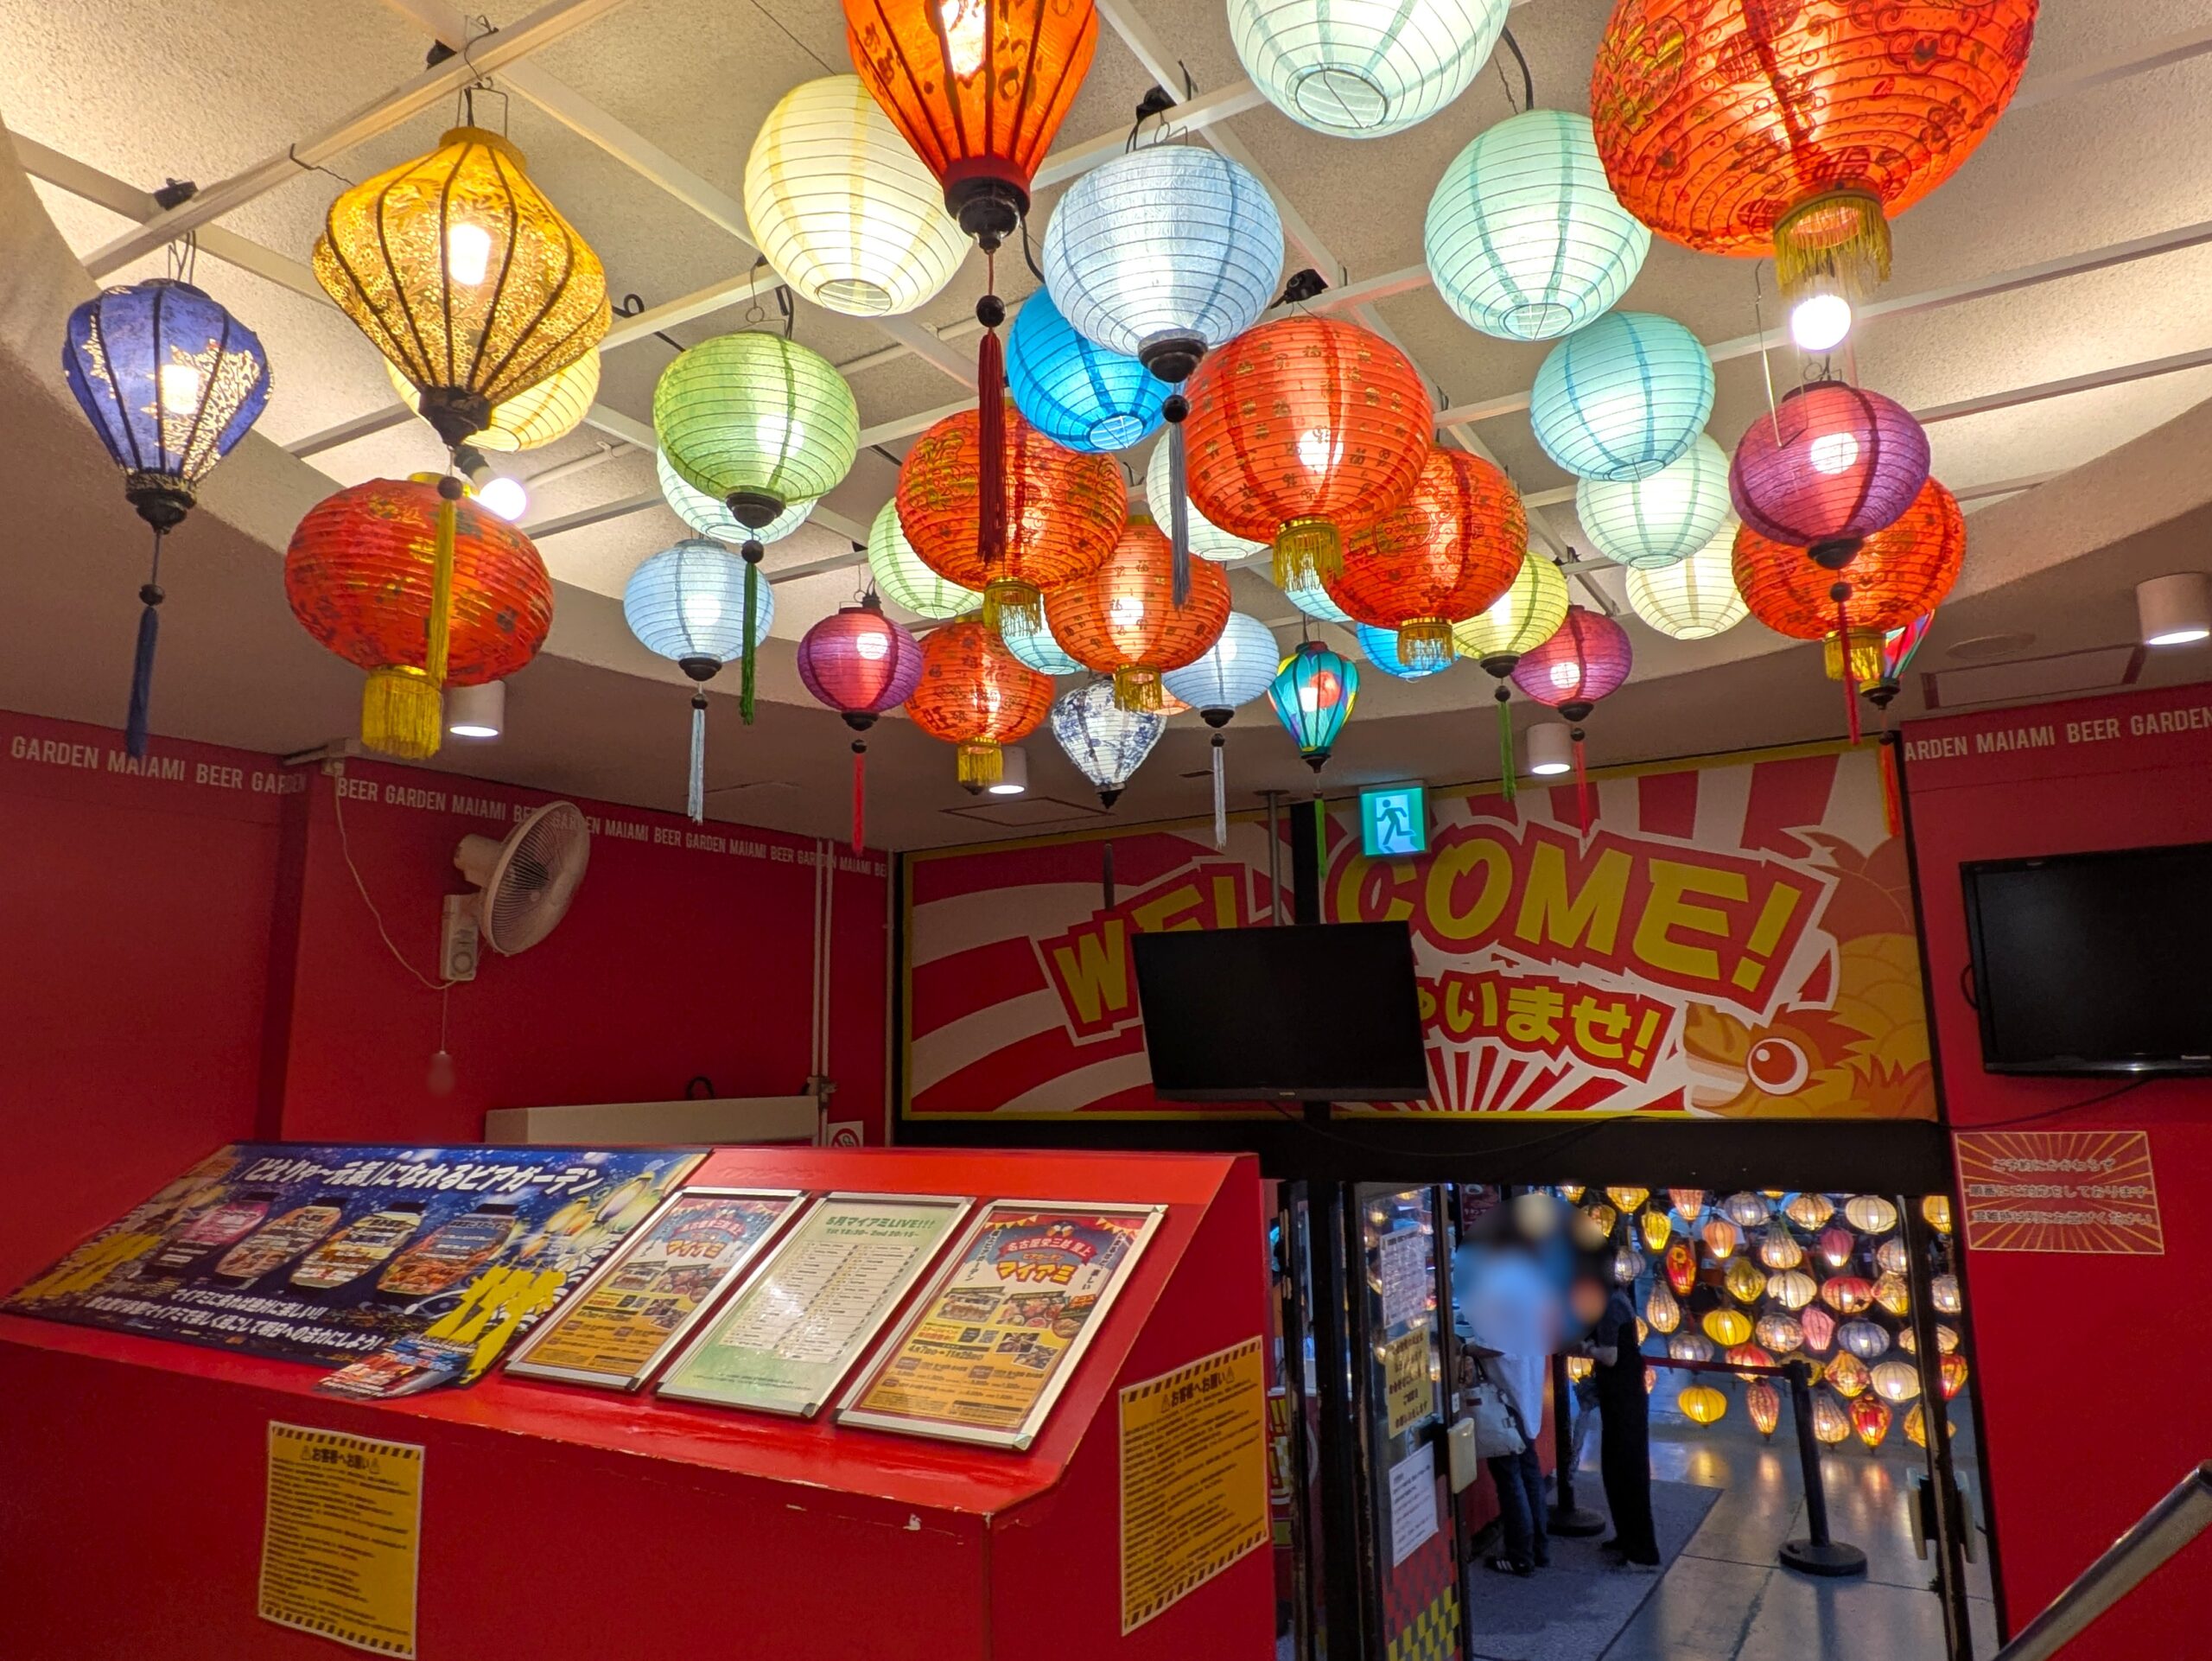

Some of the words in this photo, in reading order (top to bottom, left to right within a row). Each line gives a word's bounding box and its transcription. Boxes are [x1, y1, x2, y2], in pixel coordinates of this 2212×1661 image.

[1977, 726, 2056, 754] MAIAMI
[2067, 717, 2120, 744] BEER
[2131, 706, 2212, 736] GARDEN
[11, 736, 99, 770] GARDEN
[107, 750, 185, 781] MAIAMI
[196, 763, 243, 789] BEER
[337, 777, 378, 801] BEER
[385, 785, 446, 811] GARDEN
[452, 794, 505, 820] MAIAMI
[604, 819, 649, 842] MAIAMI
[654, 827, 681, 847] BEER
[685, 832, 726, 854] GARDEN
[729, 839, 766, 859] MAIAMI
[771, 846, 794, 862] BEER
[840, 856, 871, 875] MAIAMI
[666, 1239, 728, 1259] マイアミ
[997, 1261, 1078, 1285] マイアミ
